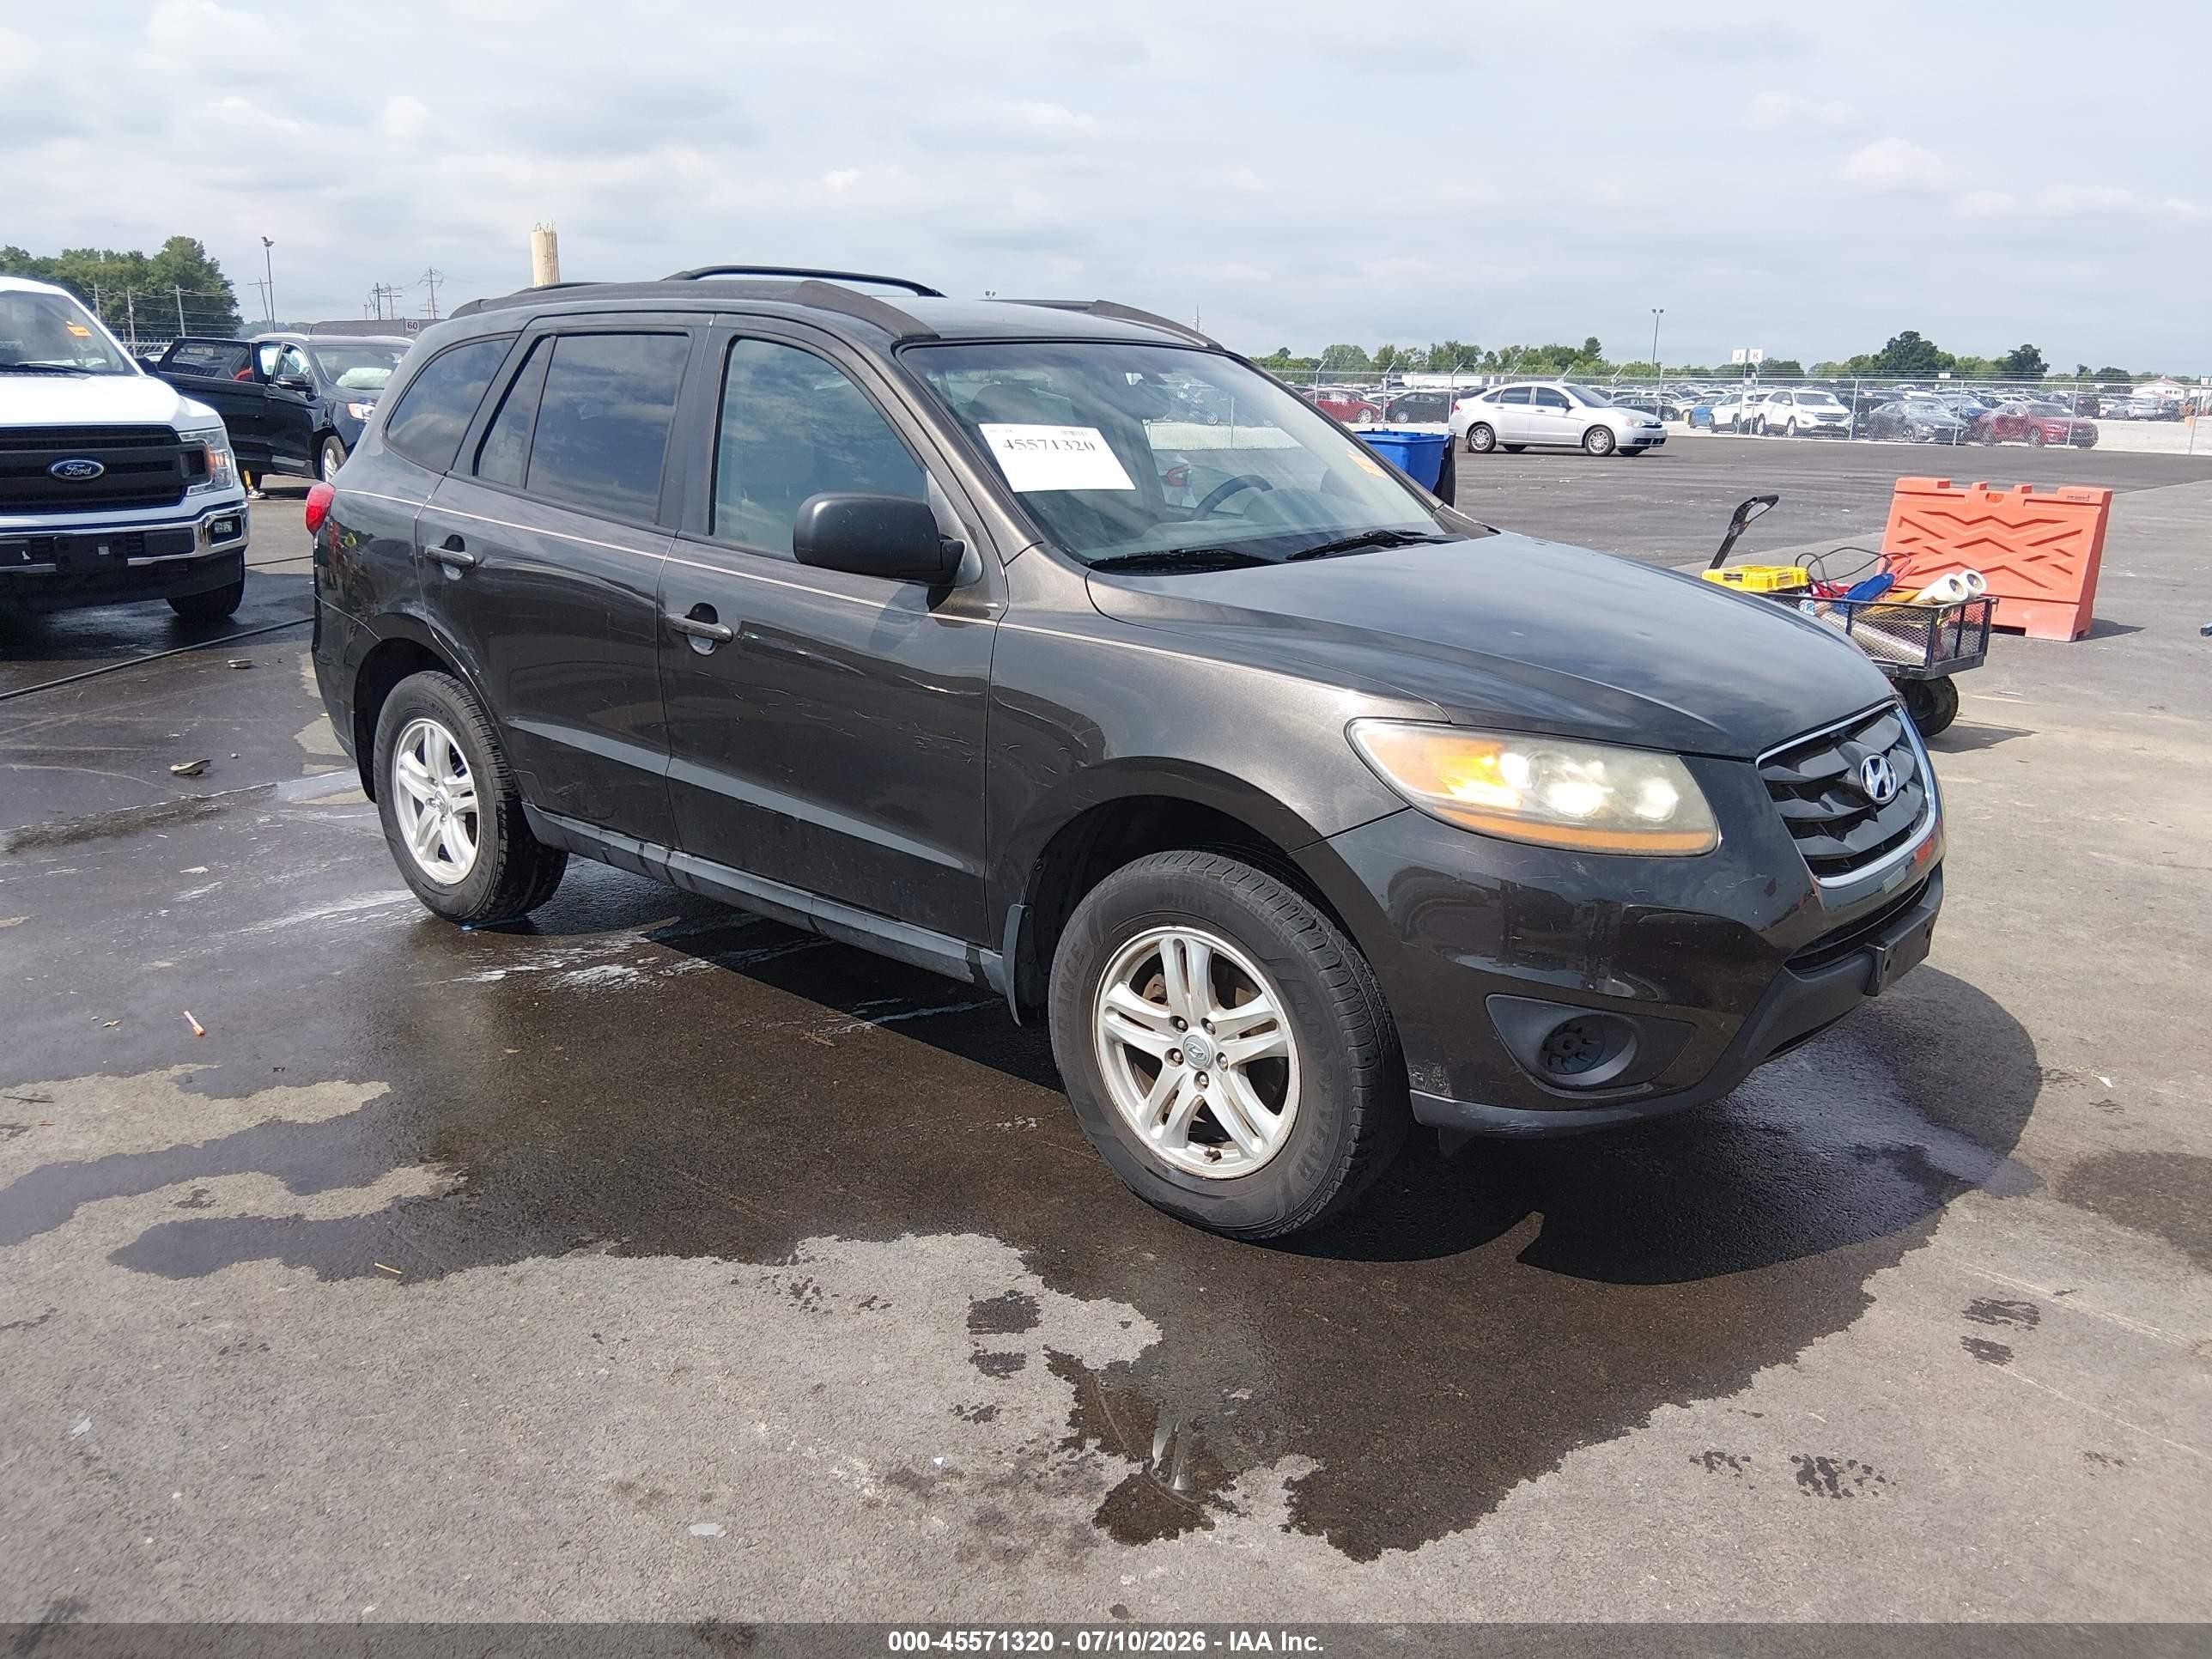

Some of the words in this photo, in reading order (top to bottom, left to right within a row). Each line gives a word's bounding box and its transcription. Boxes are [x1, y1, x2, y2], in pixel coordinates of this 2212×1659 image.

[407, 321, 418, 330] 60
[1003, 439, 1097, 452] 45571320
[64, 464, 93, 476] Ford
